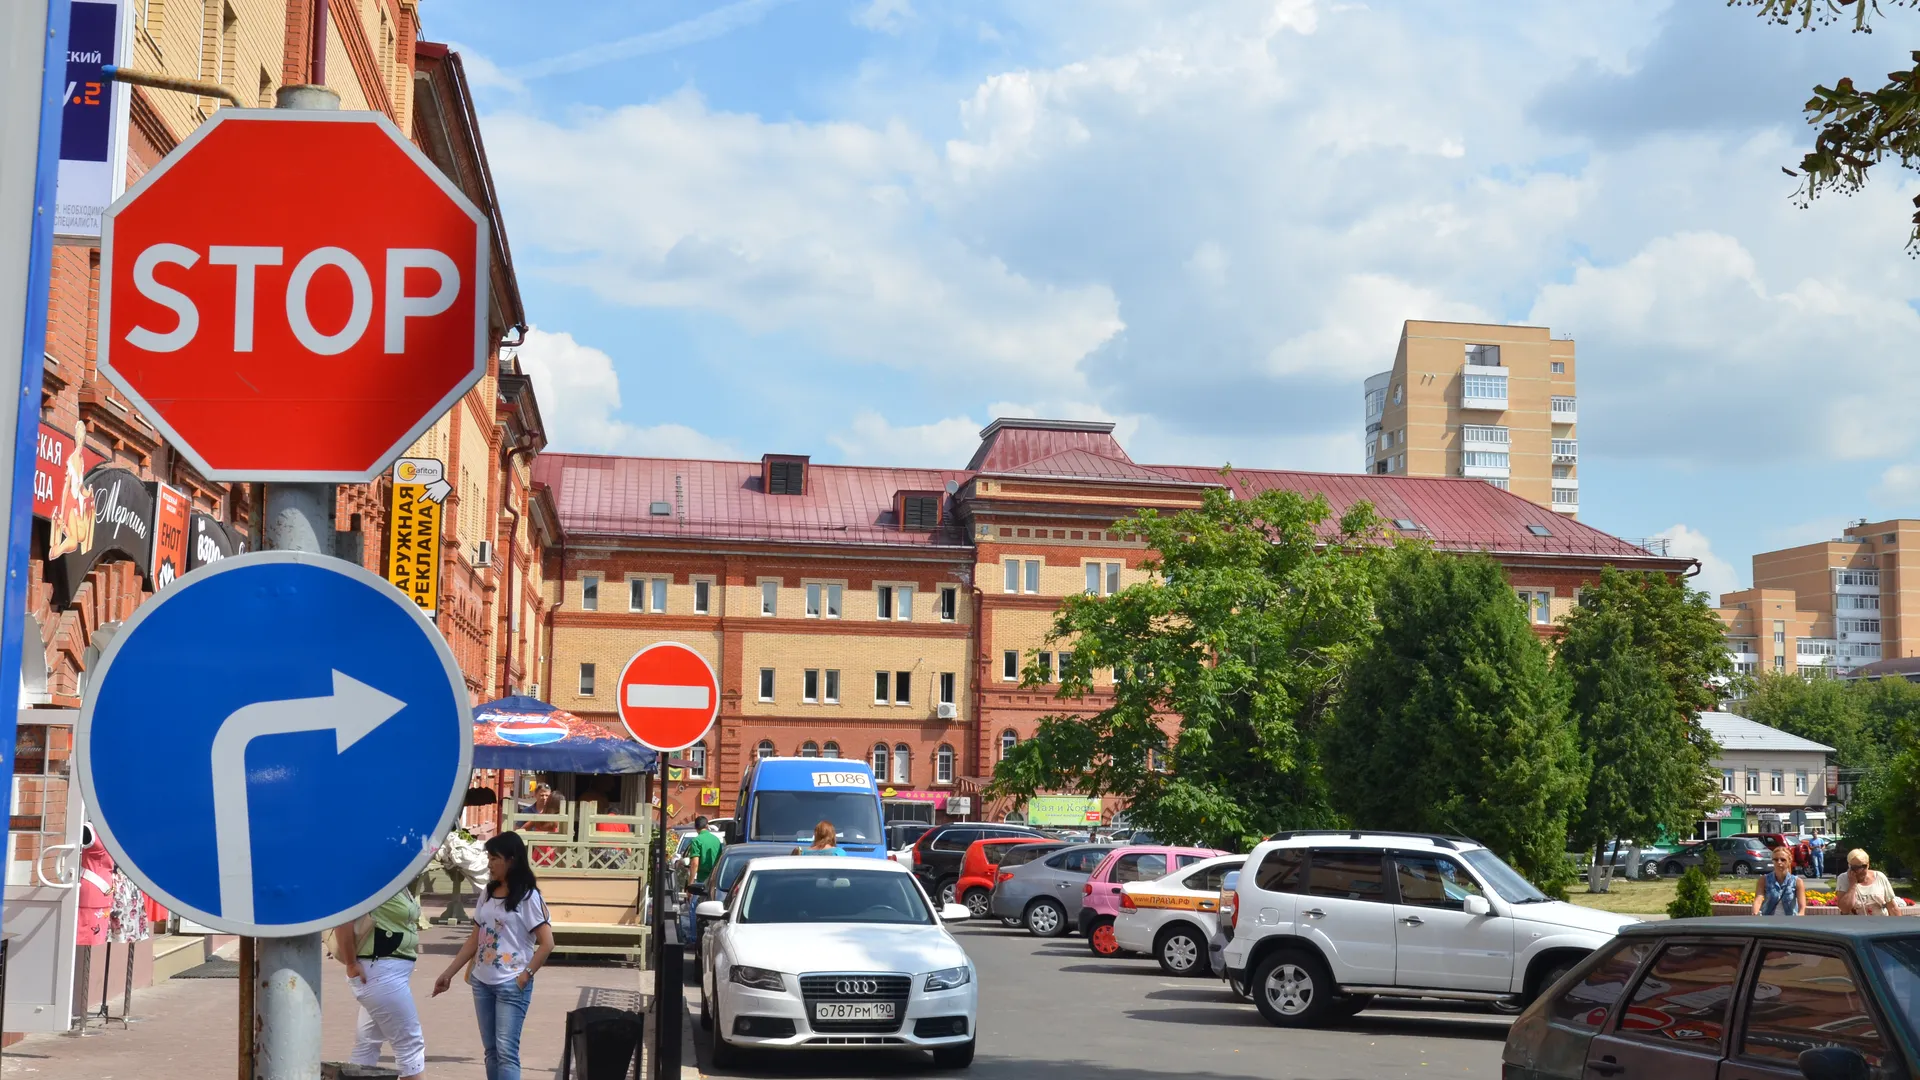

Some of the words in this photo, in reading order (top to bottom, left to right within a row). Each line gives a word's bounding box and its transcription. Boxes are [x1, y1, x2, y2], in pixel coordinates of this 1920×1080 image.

[125, 243, 460, 355] STOP
[161, 522, 182, 552] ЕНОТ
[395, 486, 414, 596] АРУЖНАЯ
[414, 505, 433, 608] РЕКЛАМА
[476, 713, 552, 724] PEPSI
[817, 773, 832, 786] Д
[835, 773, 867, 785] 086
[820, 1004, 871, 1018] О787РМ
[873, 1003, 892, 1014] 190
